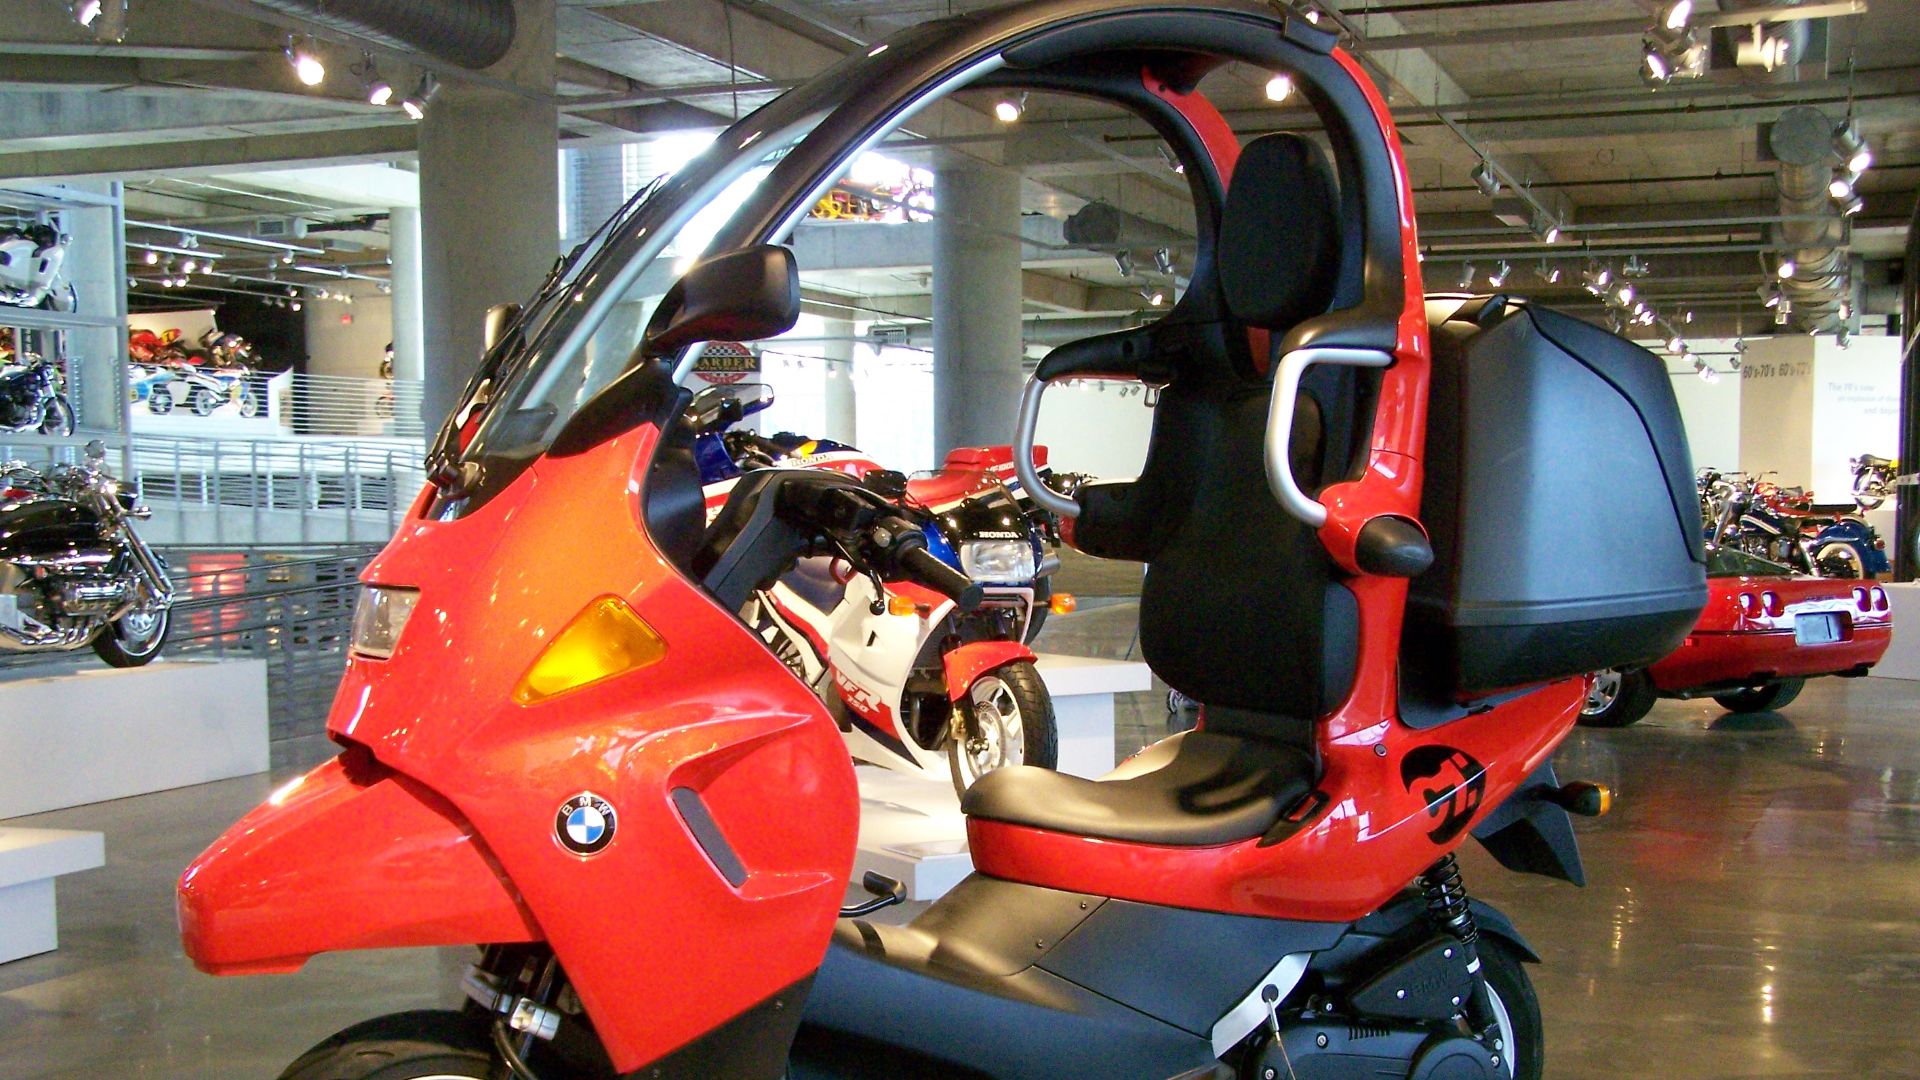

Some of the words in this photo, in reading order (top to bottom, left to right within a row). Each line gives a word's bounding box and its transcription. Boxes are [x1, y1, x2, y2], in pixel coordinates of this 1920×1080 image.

[979, 531, 1019, 539] HONDA
[836, 670, 881, 713] VFR
[561, 796, 611, 816] BMW
